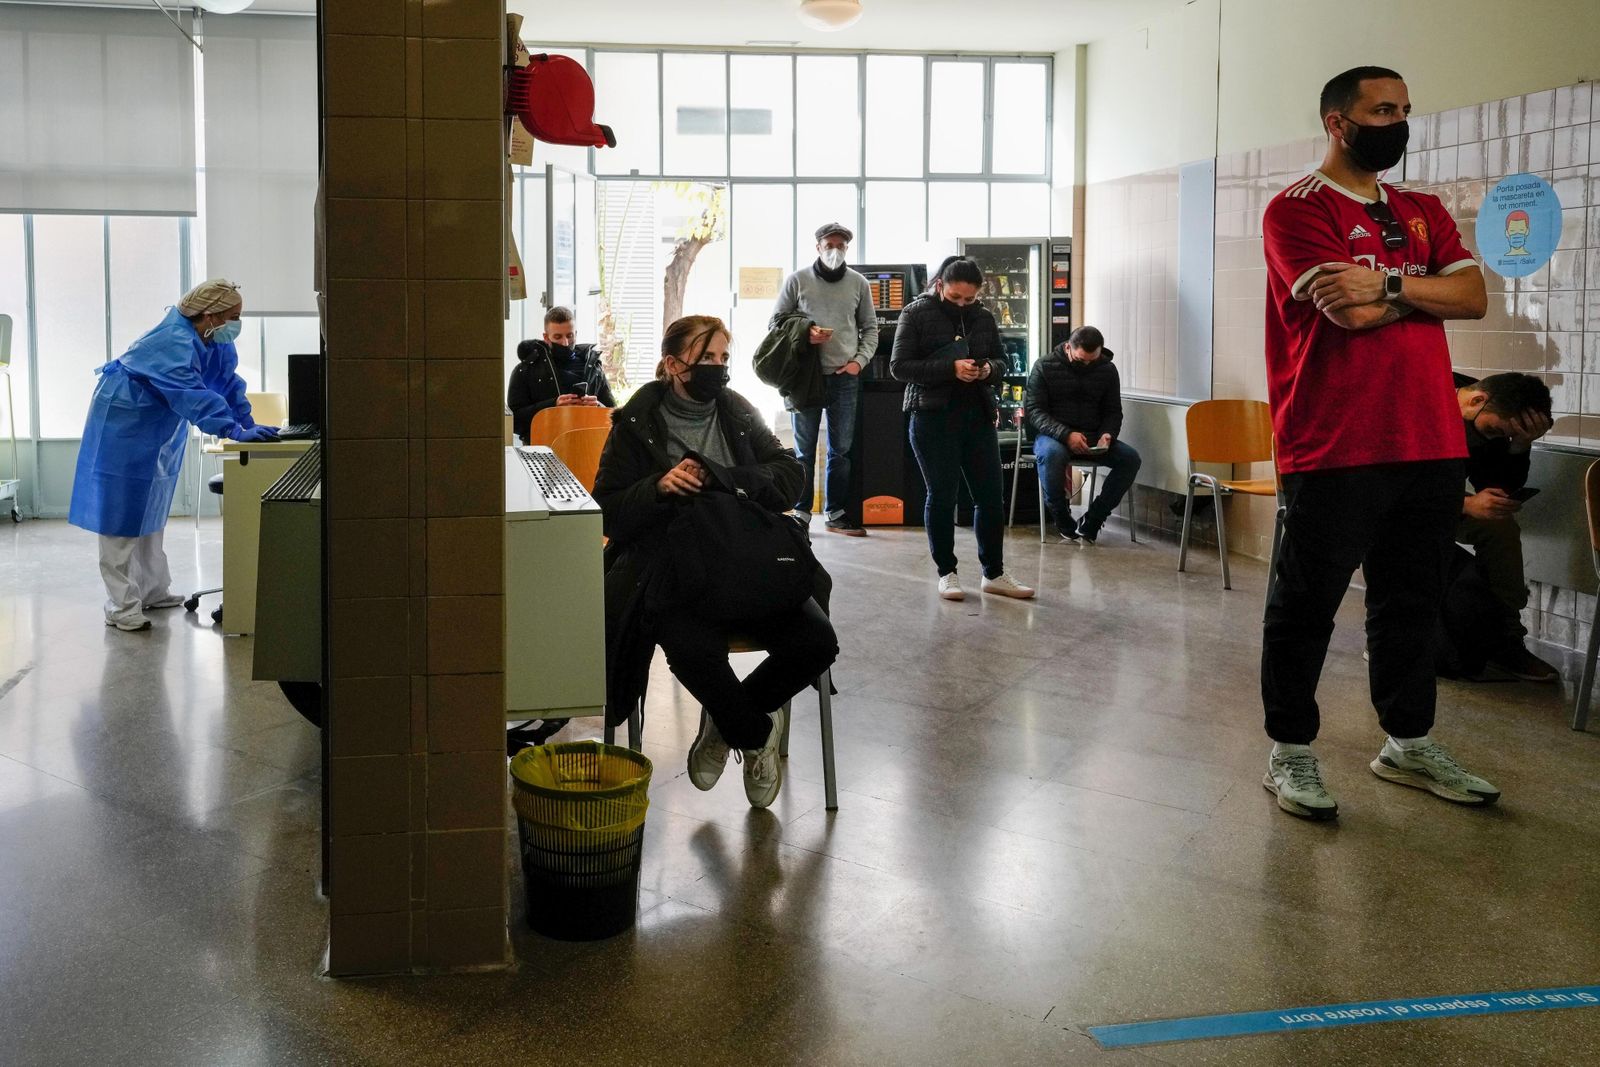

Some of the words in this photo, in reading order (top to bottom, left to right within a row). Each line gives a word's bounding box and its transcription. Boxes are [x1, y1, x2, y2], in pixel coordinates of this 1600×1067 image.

[1496, 185, 1514, 193] Porta
[1515, 181, 1541, 192] posada
[1500, 191, 1534, 202] mascareta
[1535, 190, 1545, 198] en
[1498, 202, 1507, 210] tot
[1348, 231, 1372, 240] adidas
[1491, 993, 1544, 1006] plau,
[1544, 993, 1572, 1002] us
[1572, 992, 1600, 1003] Si
[1388, 1005, 1409, 1016] el
[1410, 999, 1490, 1012] espereu
[1280, 1012, 1325, 1024] torn
[1324, 1007, 1389, 1019] vostre
